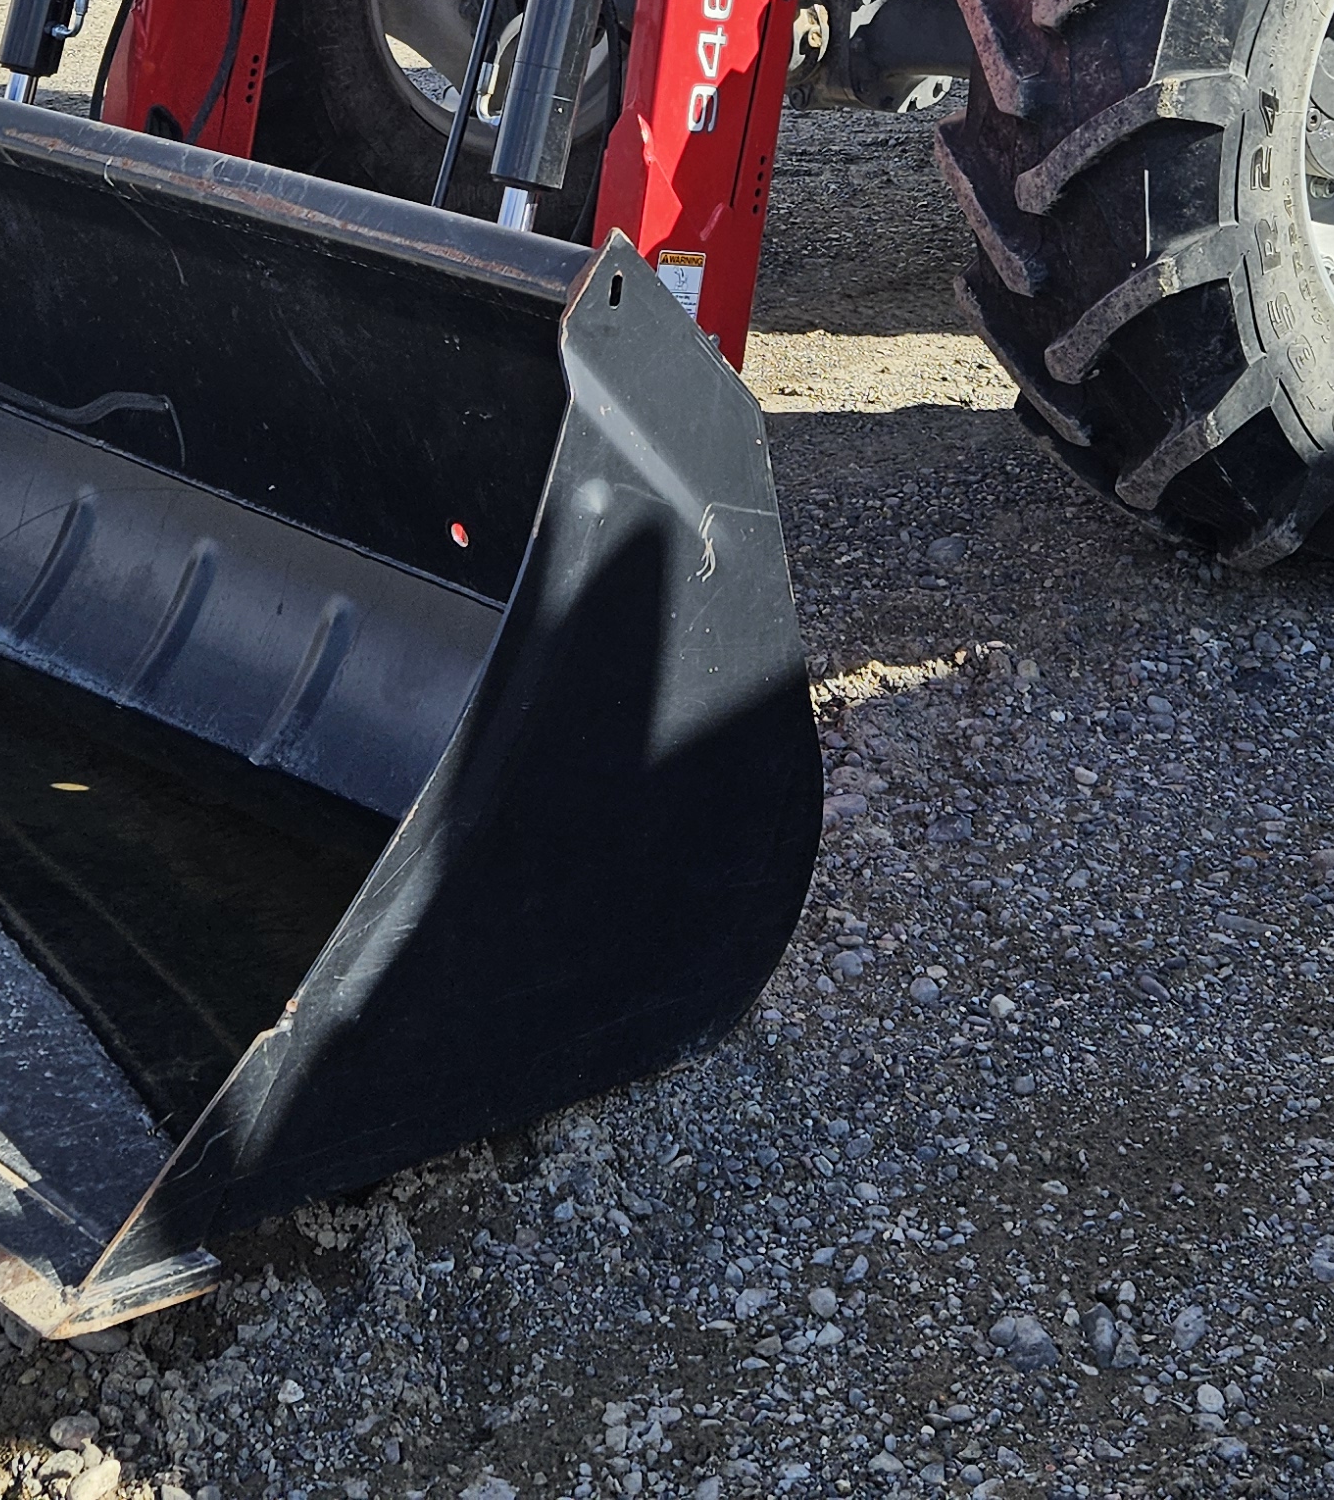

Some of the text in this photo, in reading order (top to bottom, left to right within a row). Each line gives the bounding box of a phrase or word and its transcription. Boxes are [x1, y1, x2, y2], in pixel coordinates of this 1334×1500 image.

[1249, 87, 1280, 191] 24
[670, 256, 704, 266] WARNING
[1254, 218, 1282, 276] R
